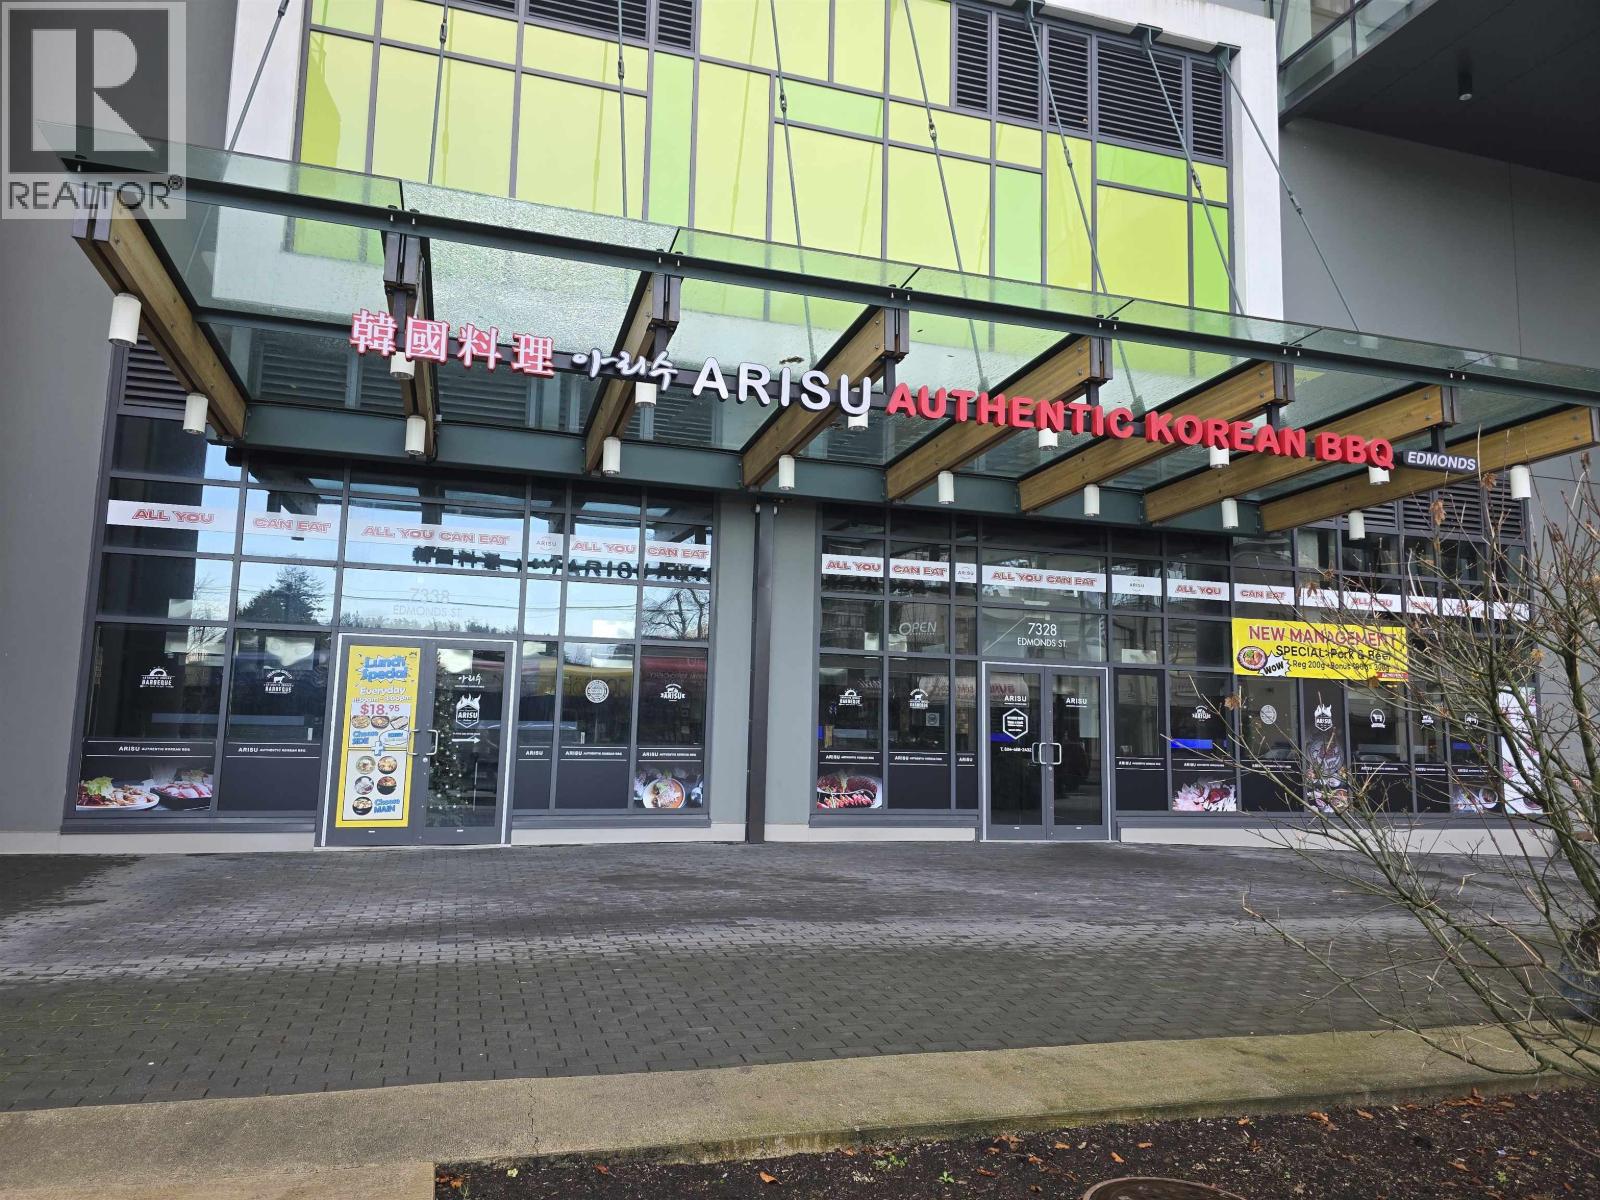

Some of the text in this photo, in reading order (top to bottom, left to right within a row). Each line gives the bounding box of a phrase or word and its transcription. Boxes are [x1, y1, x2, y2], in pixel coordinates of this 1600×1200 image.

[350, 308, 555, 378] 韓國料理
[571, 349, 678, 392] 아리수
[692, 356, 871, 416] ARISU
[885, 382, 1395, 470] AUTHENTIC KOREAN BBQ
[1408, 451, 1476, 471] EDMONDS
[132, 508, 214, 524] ALL YOU
[253, 518, 331, 533] CAN EAT
[361, 526, 511, 546] ALL YOU CAN EAT
[572, 540, 636, 554] ALL YOU
[646, 546, 709, 560] CAN EAT
[825, 560, 881, 572] ALL YOU
[892, 565, 947, 576] CAN EAT
[991, 571, 1098, 587] ALL YOU CAN EAT
[409, 587, 450, 603] 7338
[1175, 585, 1222, 595] ALL YOU
[1240, 590, 1264, 598] CAN
[393, 604, 447, 617] EDMONDS
[899, 621, 937, 636] OPEN
[1028, 622, 1057, 636] 7328
[1017, 637, 1056, 647] EDMONDS
[1249, 625, 1396, 647] NEW MANAGEMENT
[1330, 649, 1354, 659] Pork
[1293, 659, 1307, 670] Reg
[1308, 660, 1325, 670] 200g
[1065, 697, 1088, 705] ARISU
[457, 711, 478, 719] ARISU
